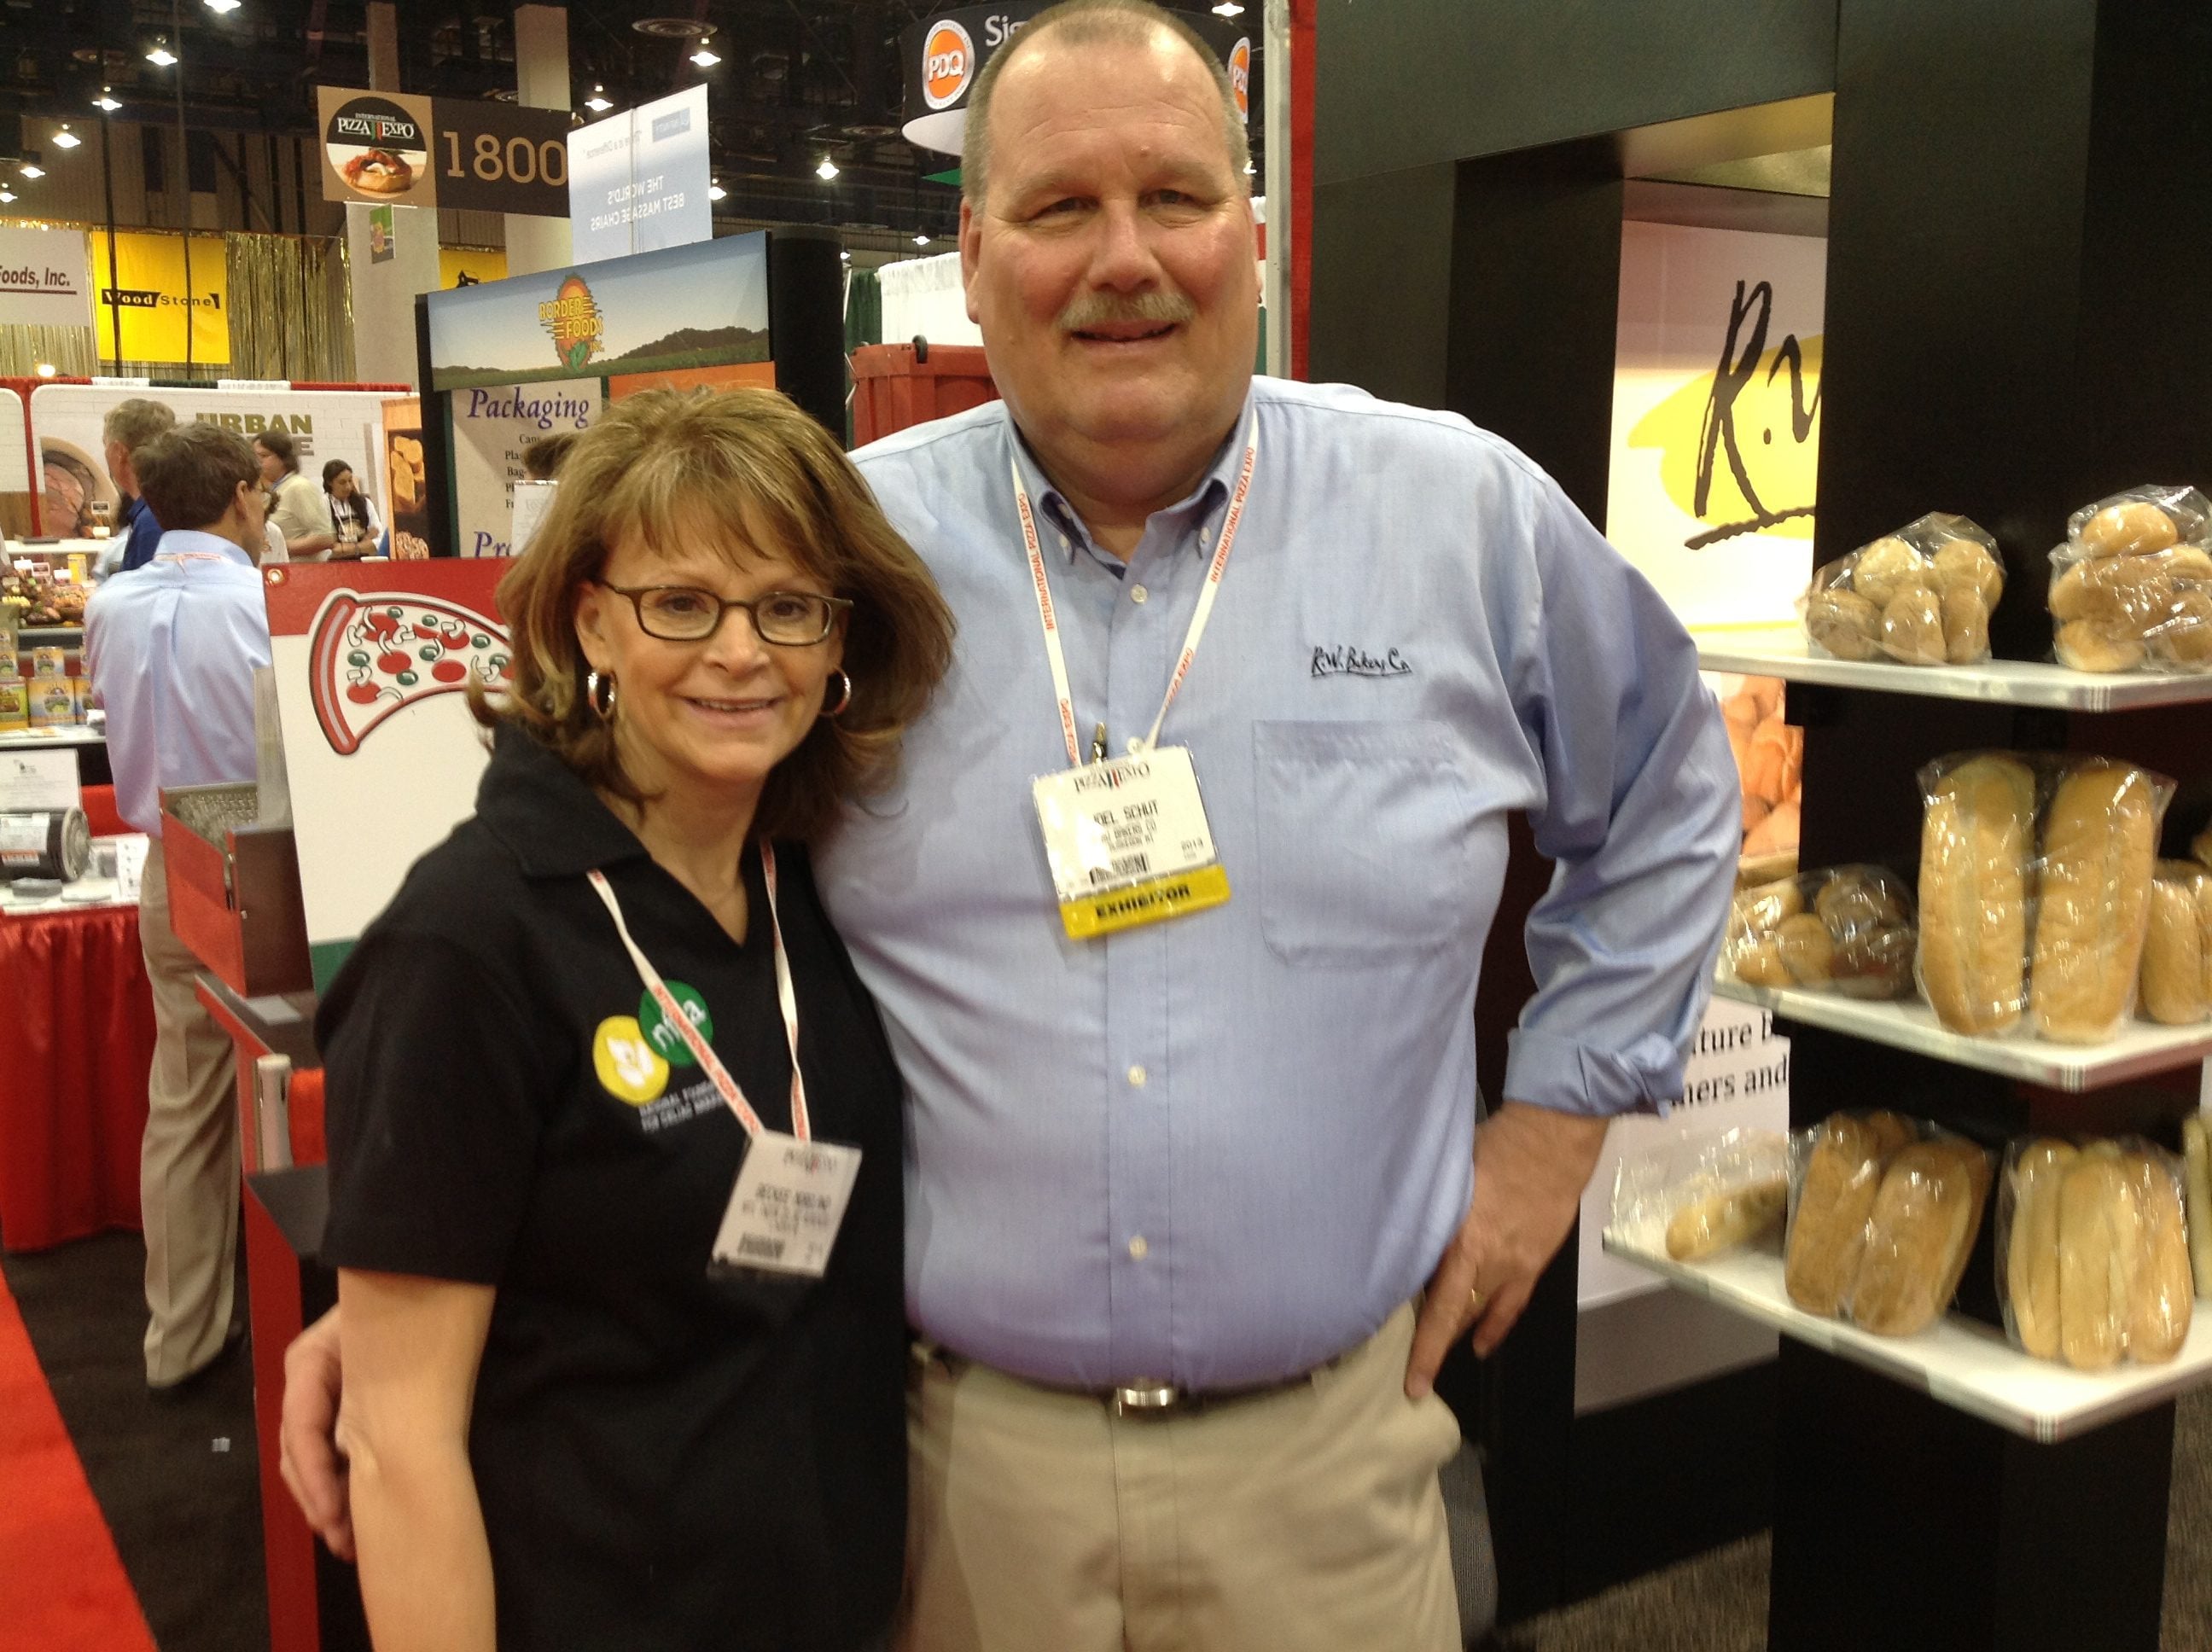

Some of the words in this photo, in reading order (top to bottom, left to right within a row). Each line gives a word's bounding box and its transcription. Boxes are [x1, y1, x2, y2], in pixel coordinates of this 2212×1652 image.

[928, 49, 964, 82] PDQ
[337, 117, 370, 135] PIZZA
[381, 121, 415, 139] EXPO
[355, 113, 396, 122] INTERNATIONAL
[443, 131, 568, 186] 1800
[44, 267, 70, 287] Inc.
[538, 297, 583, 322] BORDER
[566, 316, 603, 339] FOODS
[468, 387, 589, 429] Packaging
[505, 450, 521, 460] Pla
[1018, 492, 1031, 521] EXPO
[1210, 507, 1240, 584] INTERNATIONAL
[1234, 474, 1249, 503] PIZZA
[1243, 446, 1255, 474] EXPO
[1025, 522, 1037, 550] PIZZA
[1031, 550, 1055, 630] INTERNATIONAL
[1096, 884, 1190, 919] EXHIBITOR
[1692, 1022, 1753, 1059] ture
[1744, 1052, 1788, 1095] and
